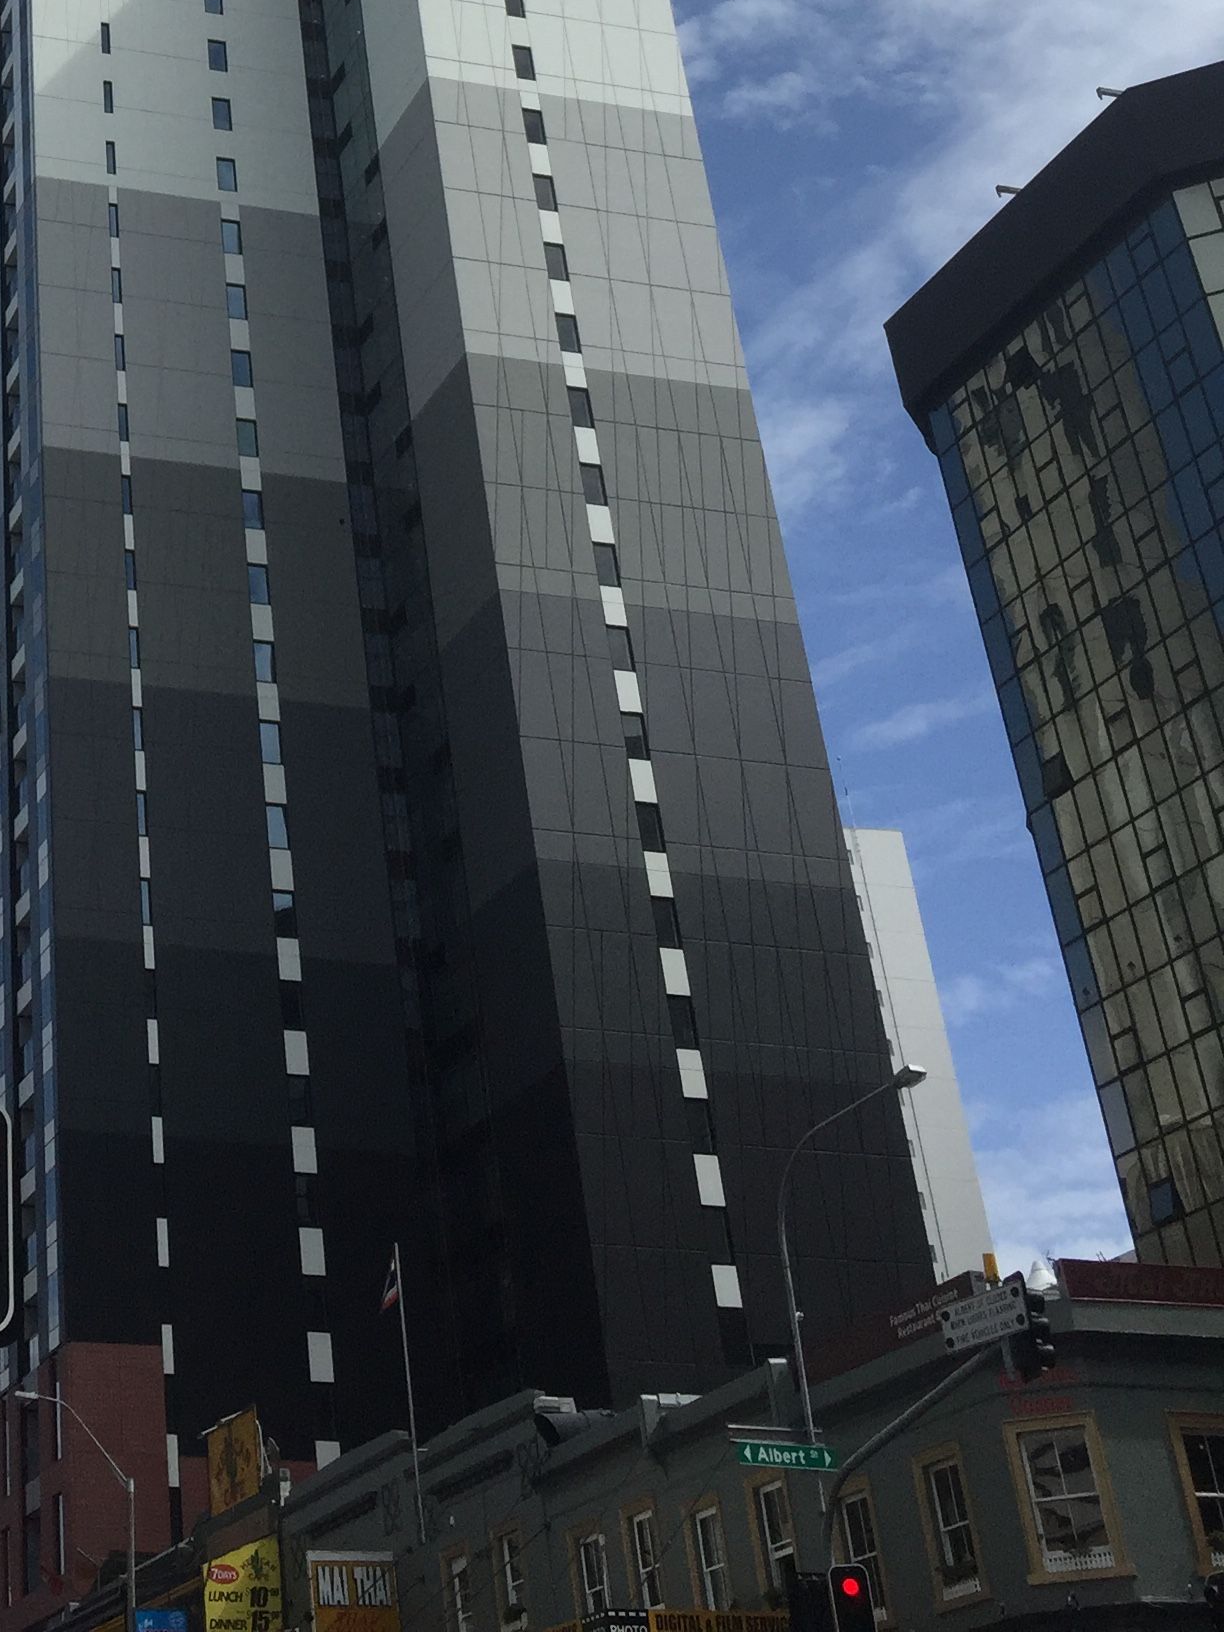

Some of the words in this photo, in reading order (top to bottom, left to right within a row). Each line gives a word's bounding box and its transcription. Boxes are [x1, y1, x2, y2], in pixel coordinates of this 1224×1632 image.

[757, 1445, 806, 1465] Albert
[317, 1565, 349, 1606] MAI
[353, 1566, 393, 1606] THAI
[208, 1591, 243, 1603] LUNCH
[209, 1619, 248, 1631] DINNER
[656, 1614, 701, 1631] DIGITAL
[716, 1615, 743, 1631] FILM
